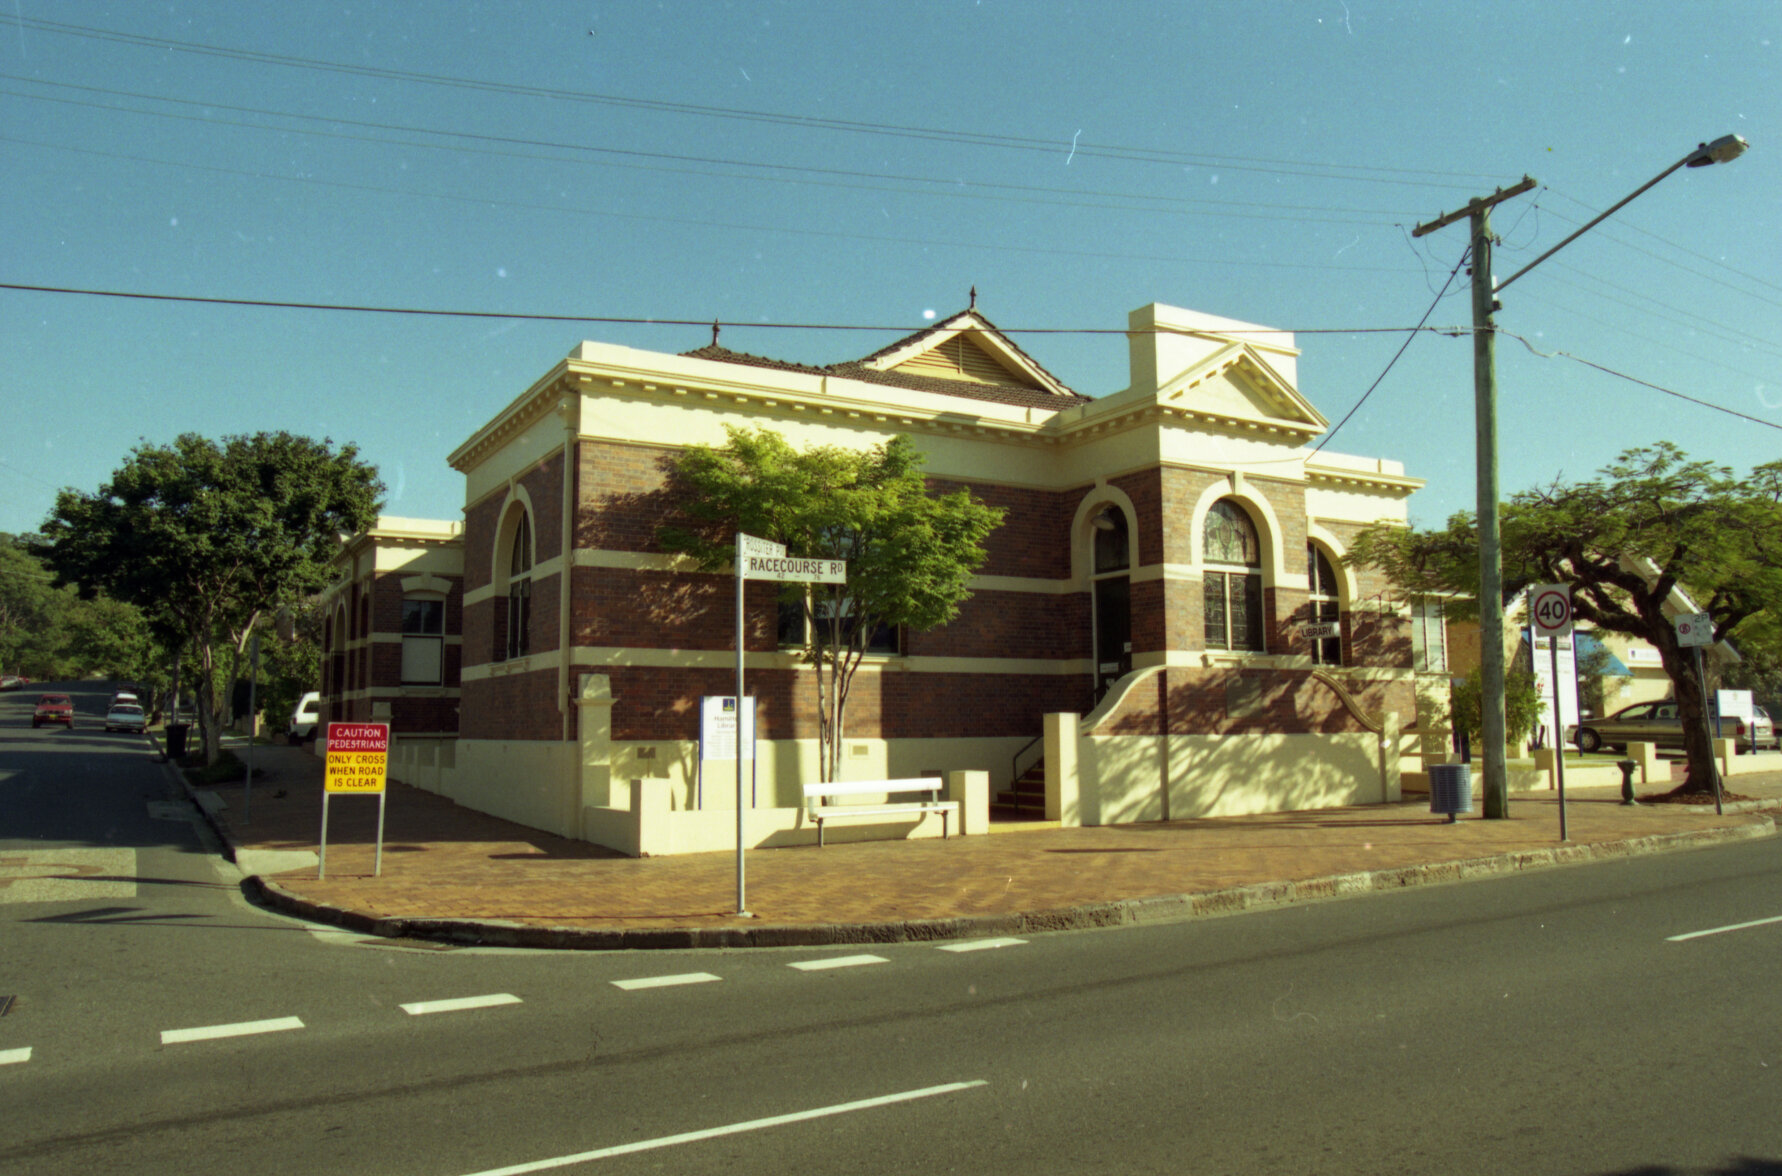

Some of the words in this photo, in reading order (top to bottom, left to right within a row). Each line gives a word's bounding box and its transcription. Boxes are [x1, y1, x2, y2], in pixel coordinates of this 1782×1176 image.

[750, 557, 824, 575] RACECOURSE
[830, 562, 843, 575] RD
[1539, 600, 1564, 620] 40
[1694, 613, 1709, 623] 2P
[1301, 625, 1332, 638] LIBRARY
[336, 728, 381, 738] CAUTION
[328, 739, 386, 749] PEDESTRIANS
[328, 755, 352, 764] ONLY
[355, 755, 385, 765] CROSS
[329, 766, 356, 775] WHEN
[358, 766, 384, 776] ROAD
[334, 778, 343, 787] IS
[346, 778, 377, 787] CLEAR
